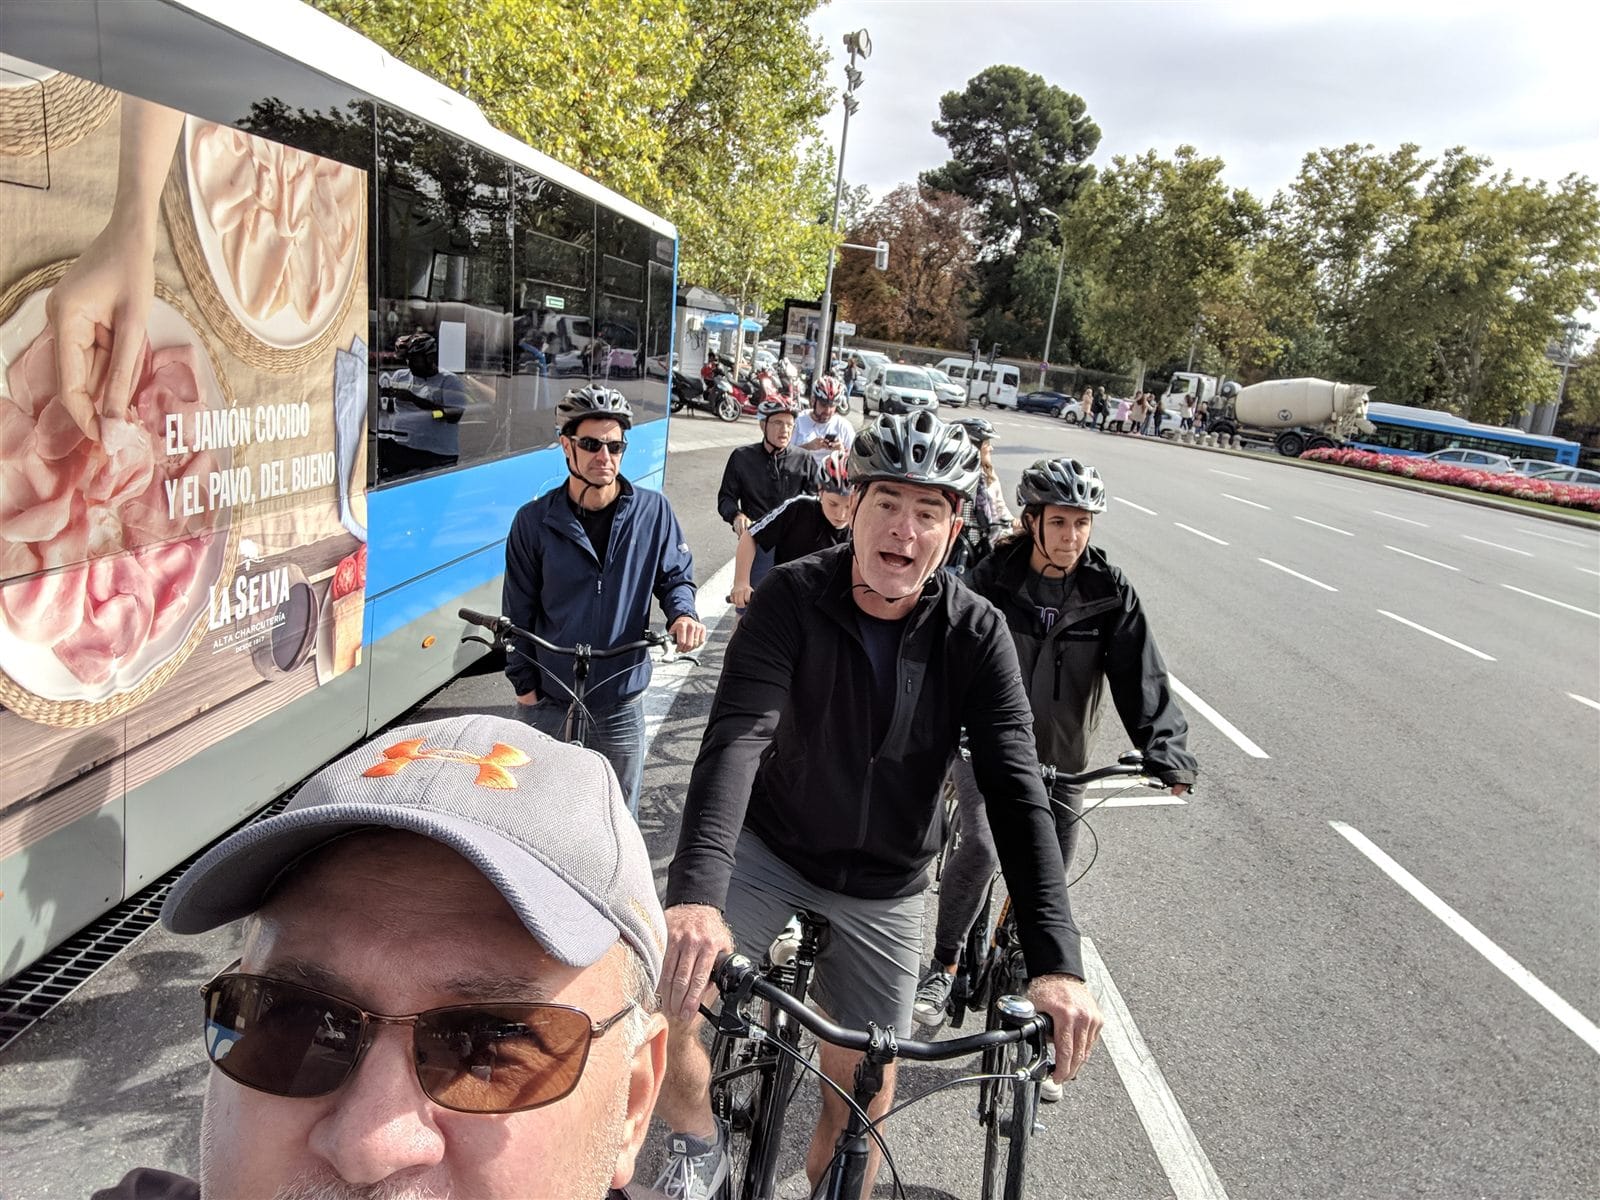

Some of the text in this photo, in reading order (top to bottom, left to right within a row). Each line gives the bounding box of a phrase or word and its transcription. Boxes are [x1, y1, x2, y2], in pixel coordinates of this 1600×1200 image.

[166, 400, 310, 455] EL JAMÓN COCIDO
[165, 451, 336, 520] Y EL PAVO, DEL BUENO
[209, 566, 290, 631] LA SELVA
[213, 612, 286, 649] ALTA CHARCUTERÍA
